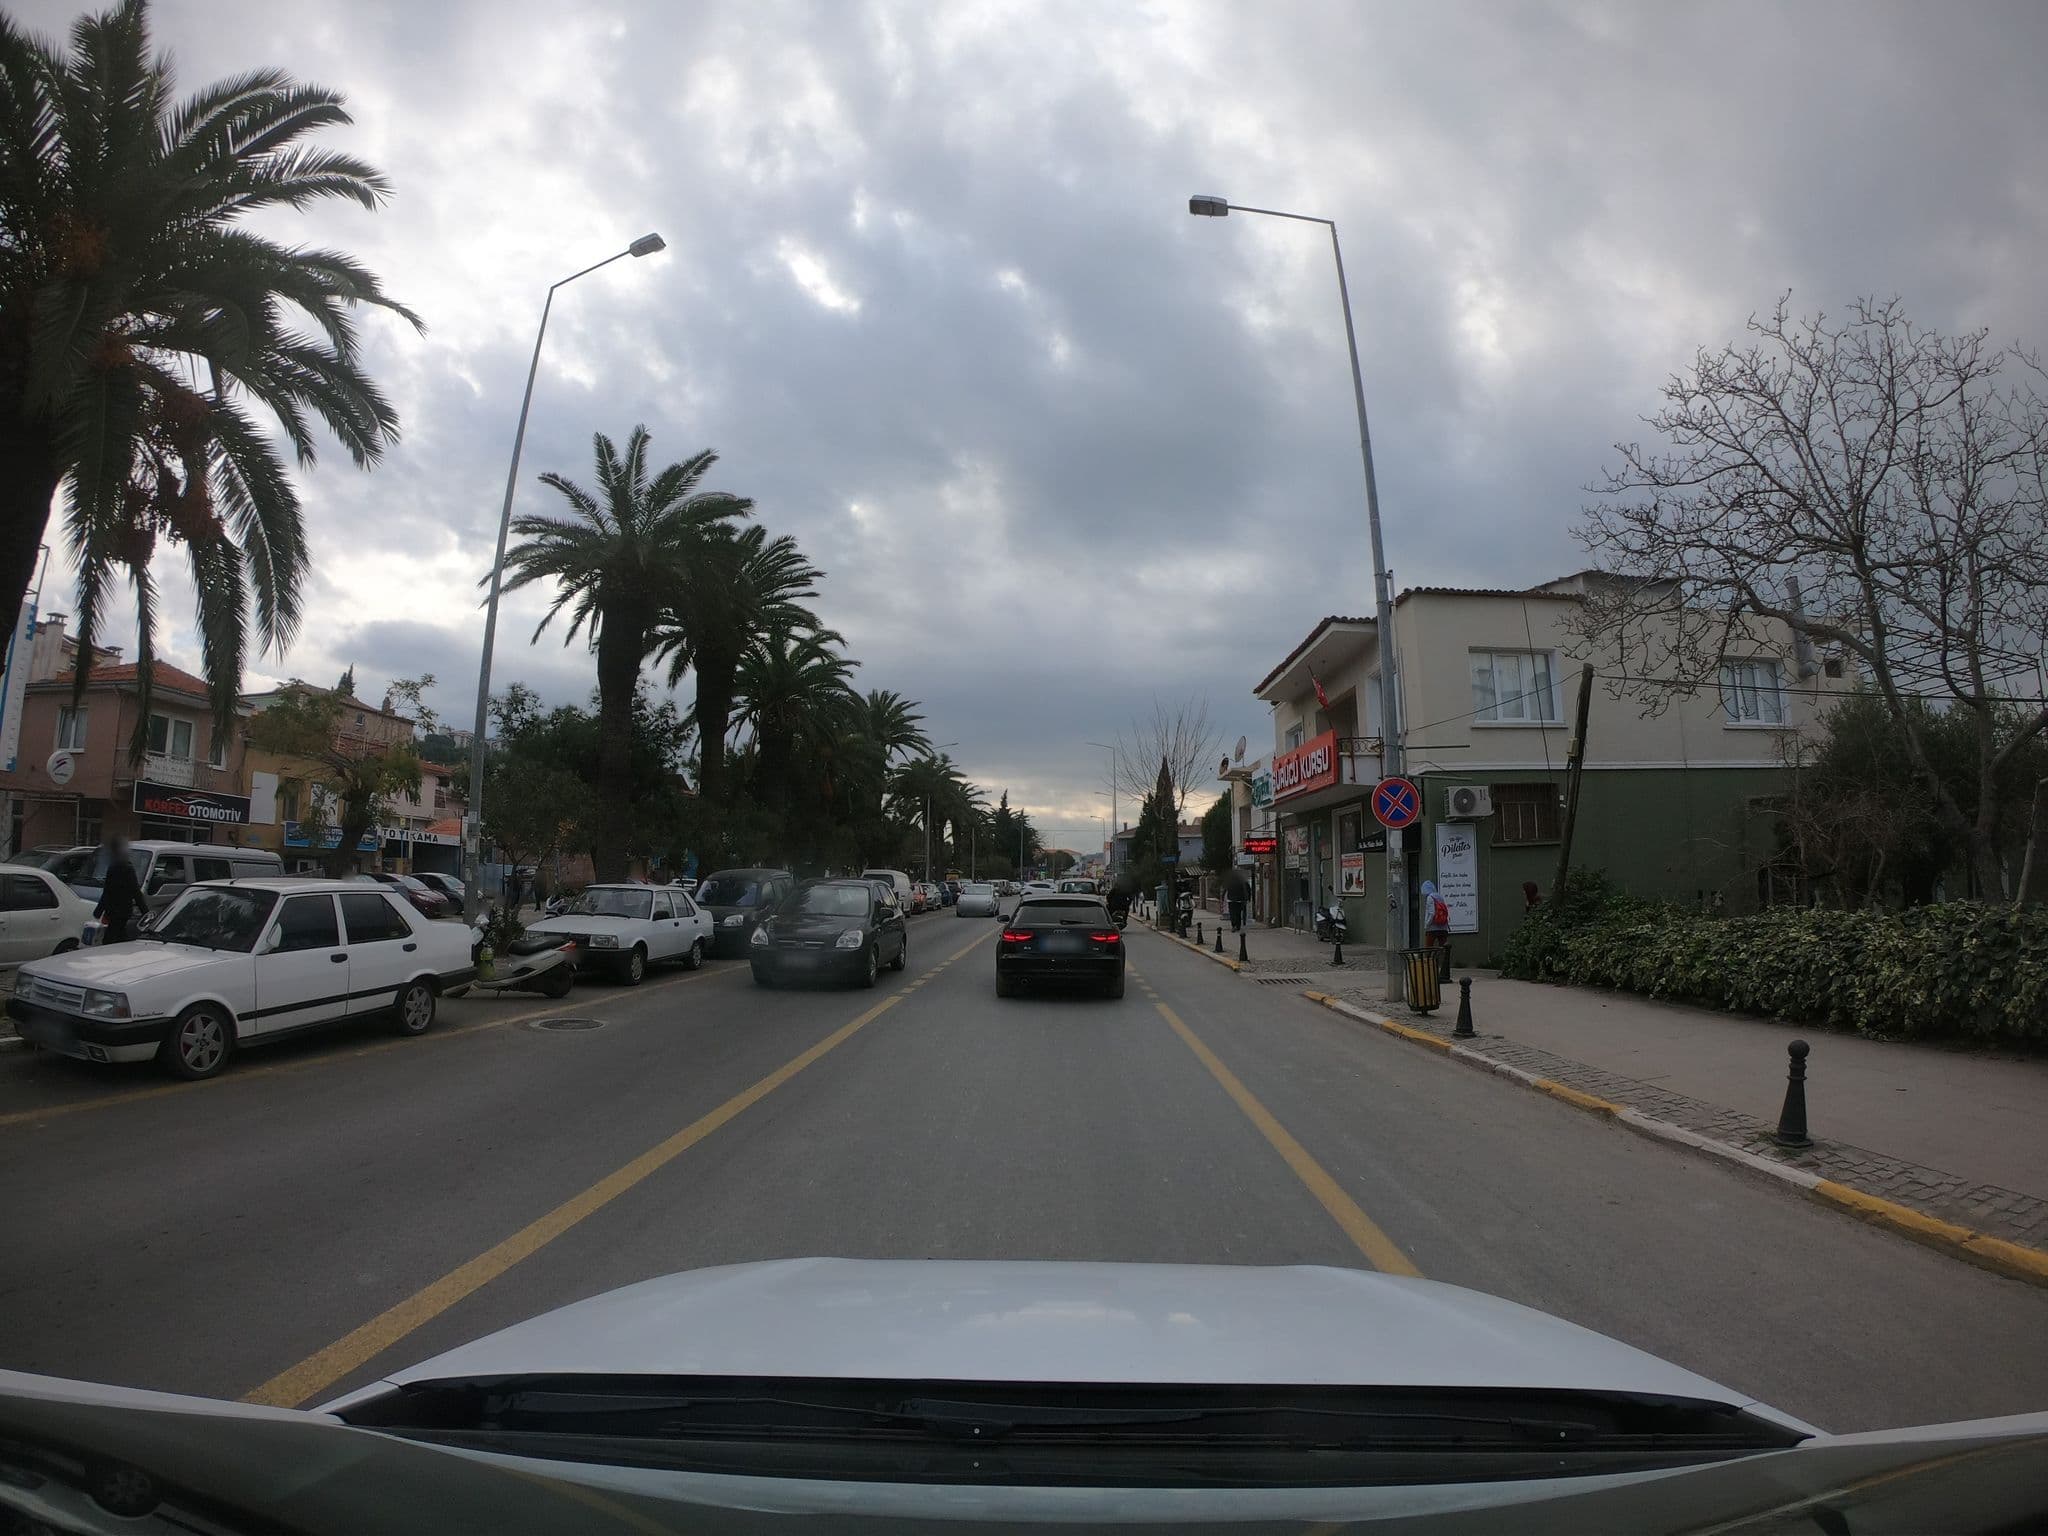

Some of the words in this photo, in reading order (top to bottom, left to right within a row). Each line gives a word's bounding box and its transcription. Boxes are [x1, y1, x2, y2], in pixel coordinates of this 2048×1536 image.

[1300, 745, 1329, 780] KURSU
[188, 804, 242, 822] OTOMOTİV
[399, 830, 439, 843] YIKAMA
[1441, 842, 1471, 857] Pilates
